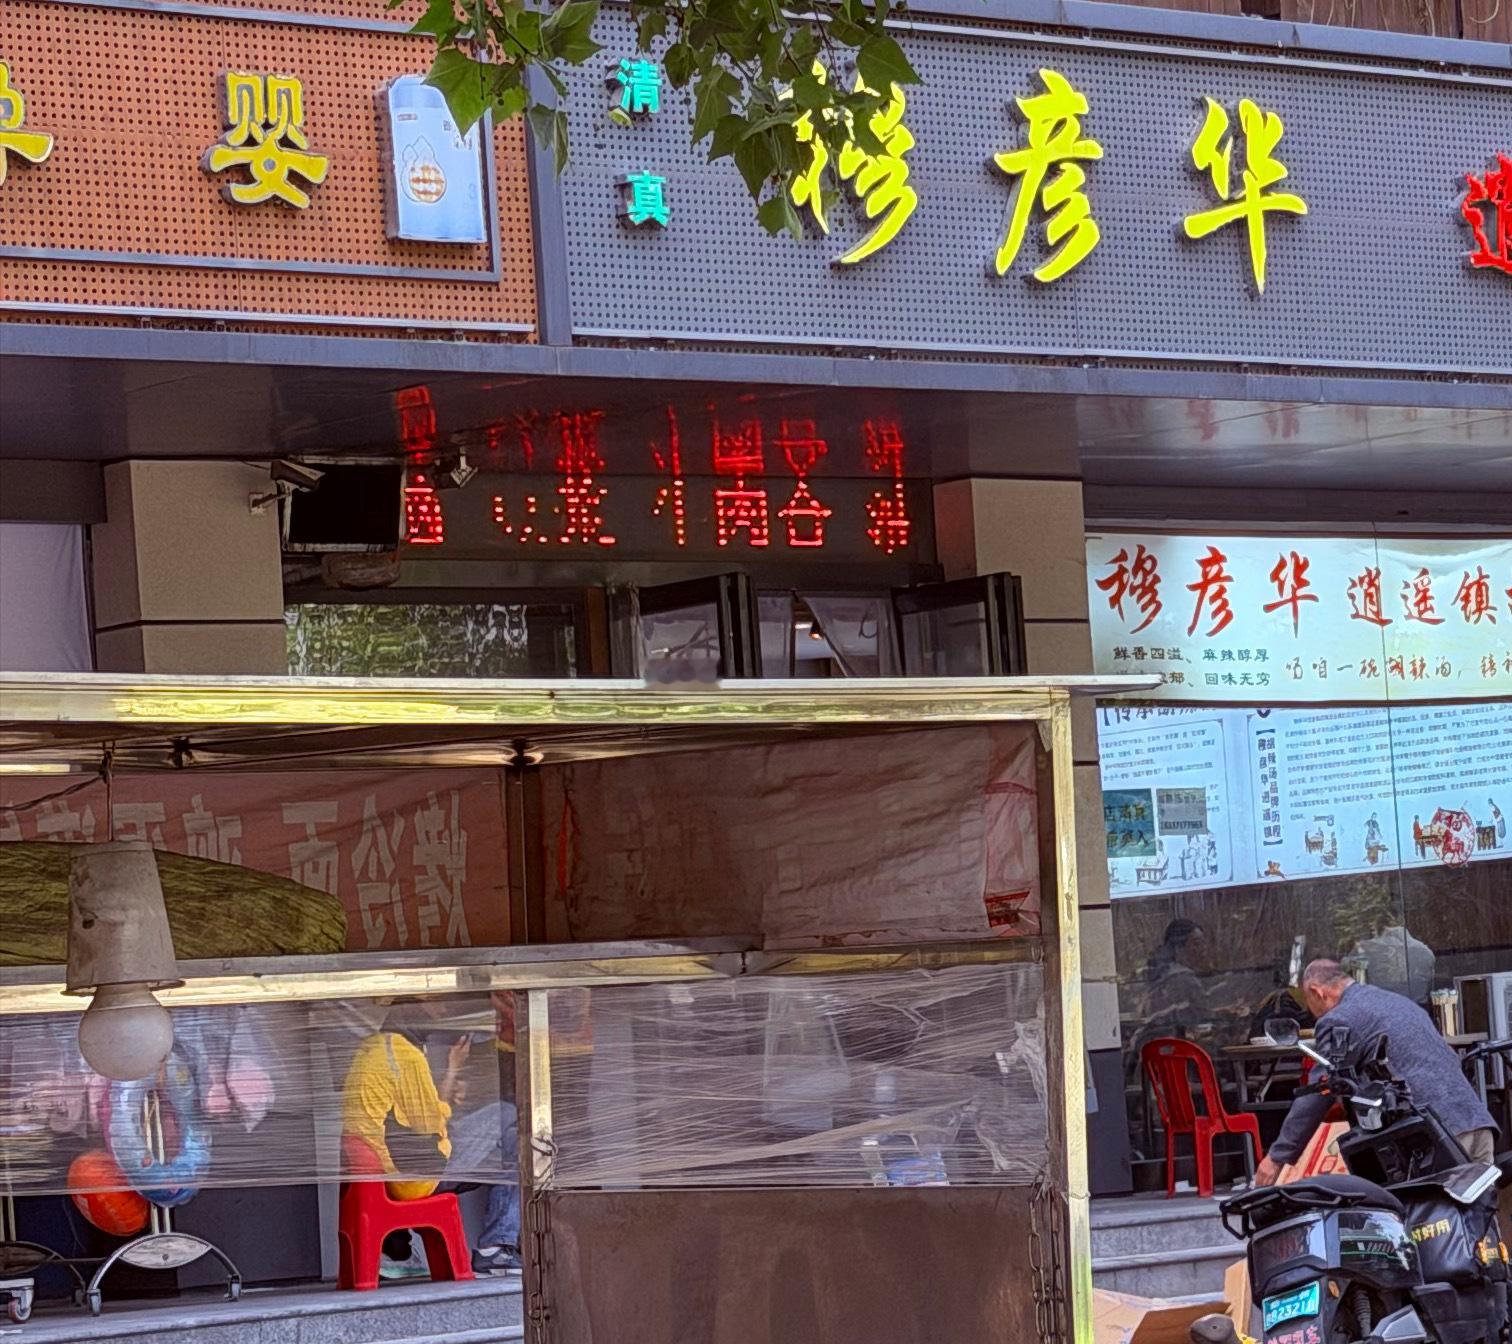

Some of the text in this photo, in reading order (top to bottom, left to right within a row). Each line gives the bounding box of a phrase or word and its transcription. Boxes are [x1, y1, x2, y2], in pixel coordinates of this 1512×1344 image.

[616, 57, 670, 229] 清真
[1095, 544, 1320, 638] 穆彦华
